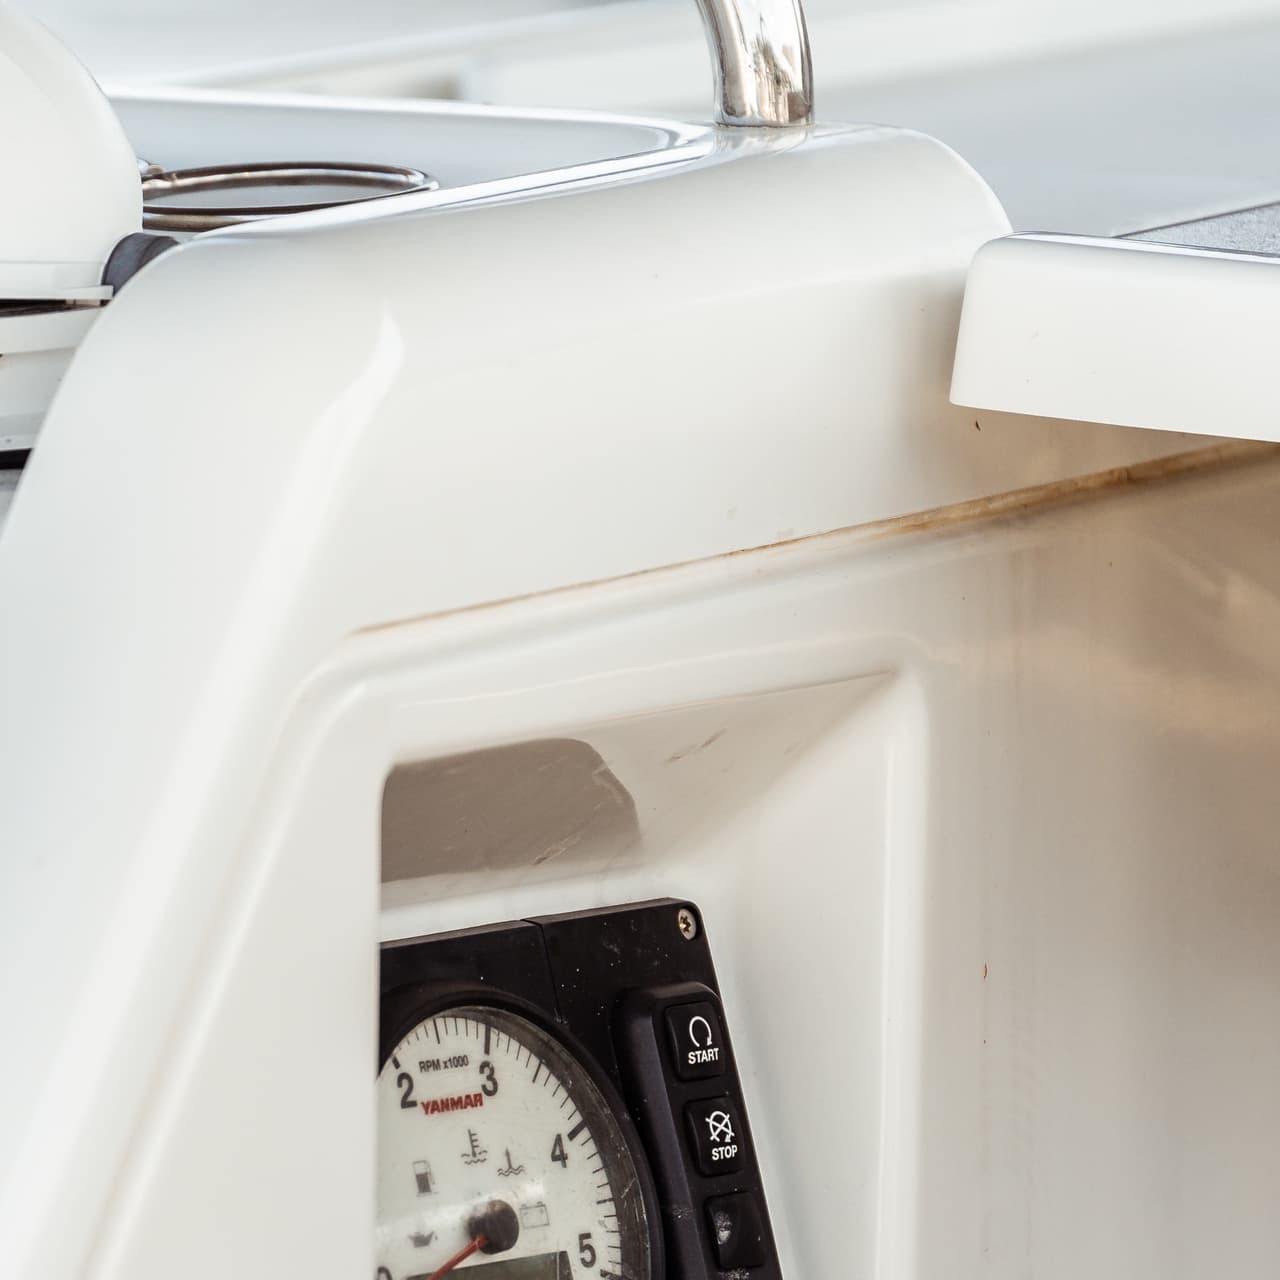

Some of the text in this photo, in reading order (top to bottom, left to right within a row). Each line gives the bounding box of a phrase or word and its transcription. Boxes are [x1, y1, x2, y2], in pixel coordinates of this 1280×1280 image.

[419, 1055, 469, 1073] RPM x1000
[688, 1048, 719, 1065] START
[397, 1072, 418, 1110] 2
[479, 1061, 498, 1097] 3
[420, 1092, 484, 1115] YANMAR
[551, 1134, 568, 1168] 4
[711, 1145, 738, 1161] STOP
[578, 1232, 596, 1268] 5
